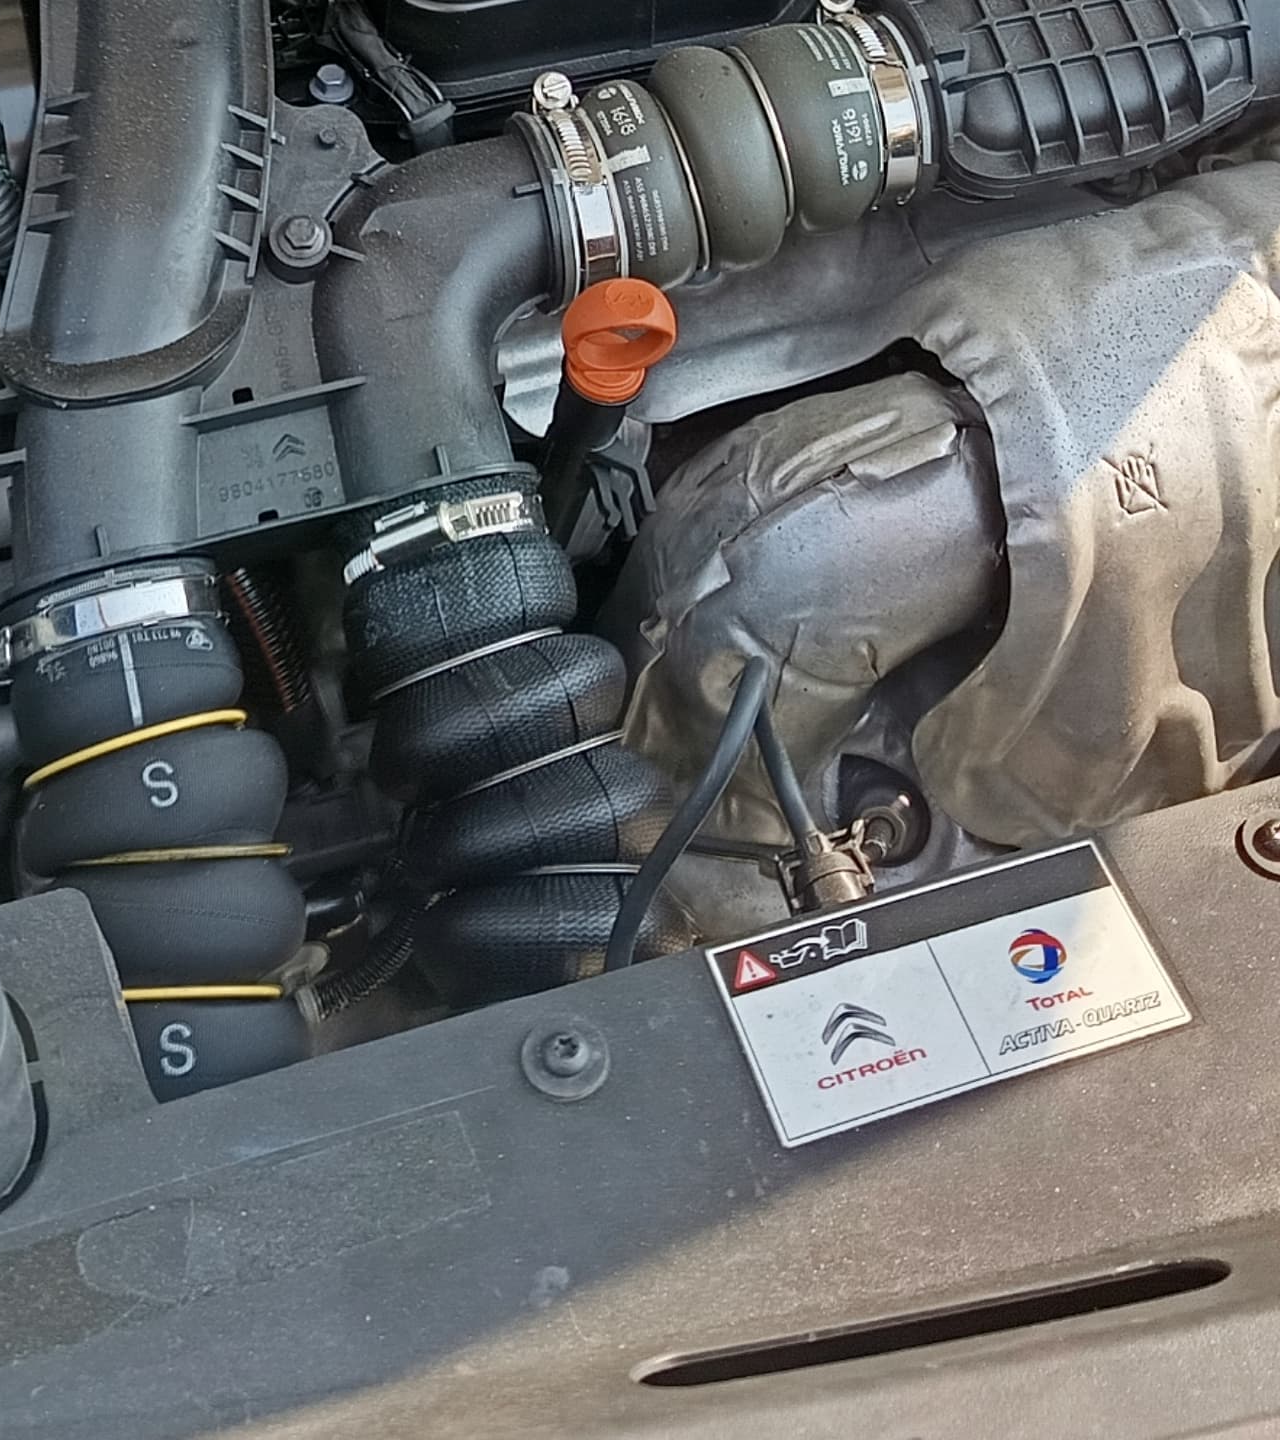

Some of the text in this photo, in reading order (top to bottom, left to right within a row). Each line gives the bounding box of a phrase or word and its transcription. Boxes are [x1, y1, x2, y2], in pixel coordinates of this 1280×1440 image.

[608, 102, 639, 139] 1618
[842, 108, 863, 144] 1618
[141, 760, 179, 808] S
[1025, 987, 1094, 1011] TOTAL
[159, 1023, 197, 1076] S
